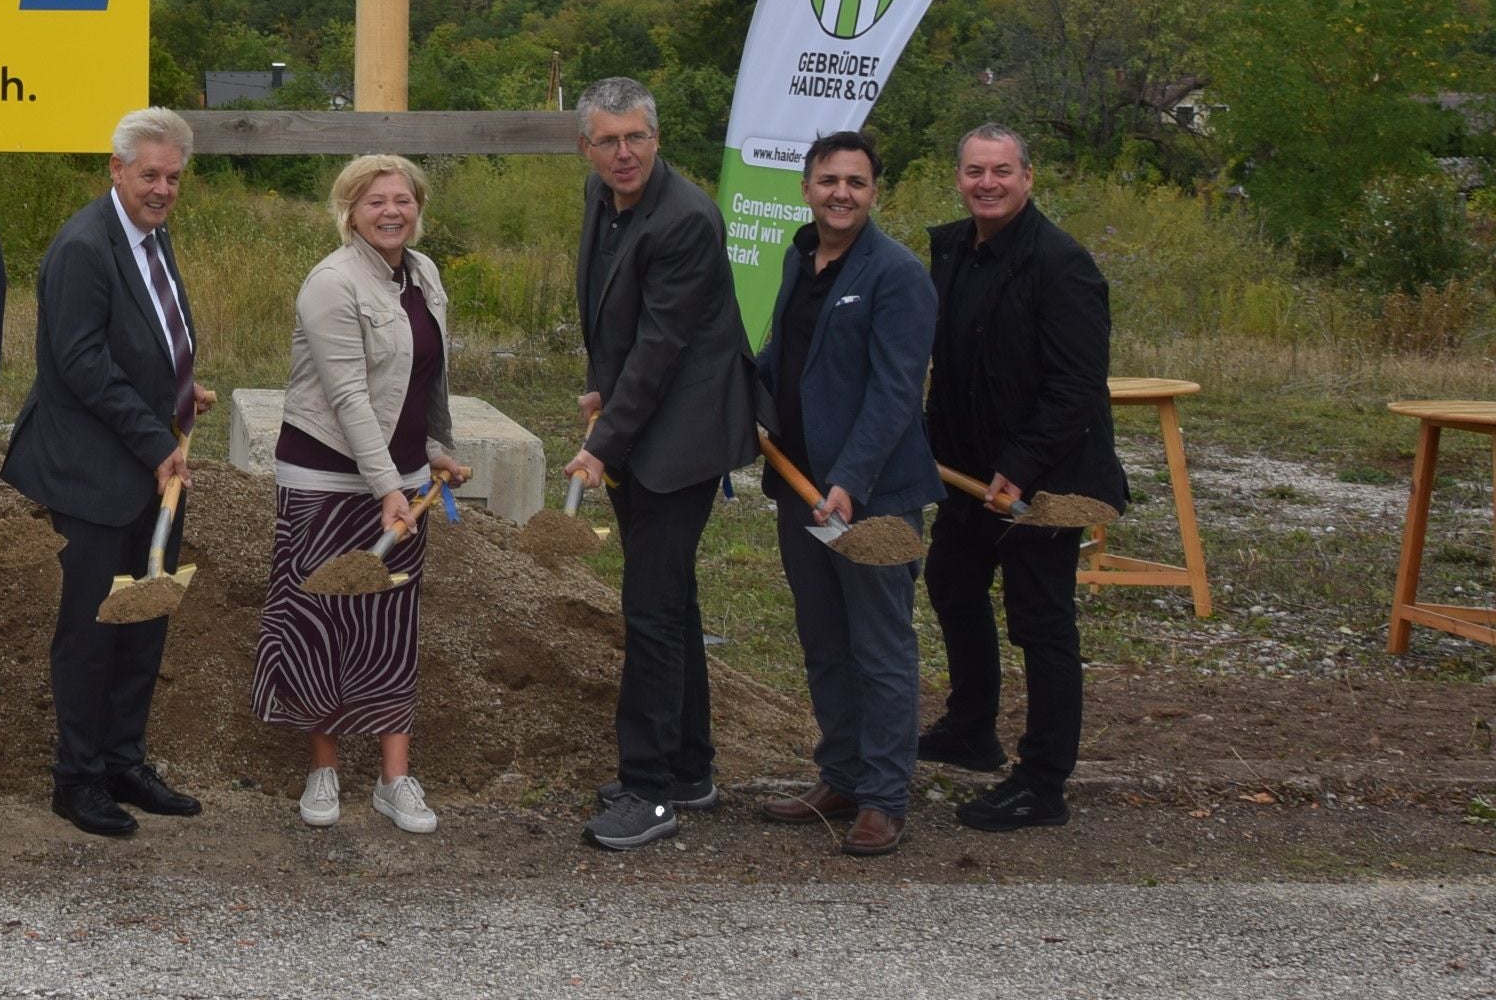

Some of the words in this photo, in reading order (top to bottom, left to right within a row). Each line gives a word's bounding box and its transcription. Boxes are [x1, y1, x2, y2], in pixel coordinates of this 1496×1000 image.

[798, 50, 880, 77] GEBRÜDER
[789, 76, 842, 99] HAIDER
[844, 80, 856, 100] &
[754, 147, 805, 162] www.haider-
[733, 193, 812, 222] Gemeinsam
[729, 217, 759, 240] sind
[761, 223, 784, 244] wir
[727, 244, 759, 266] stark
